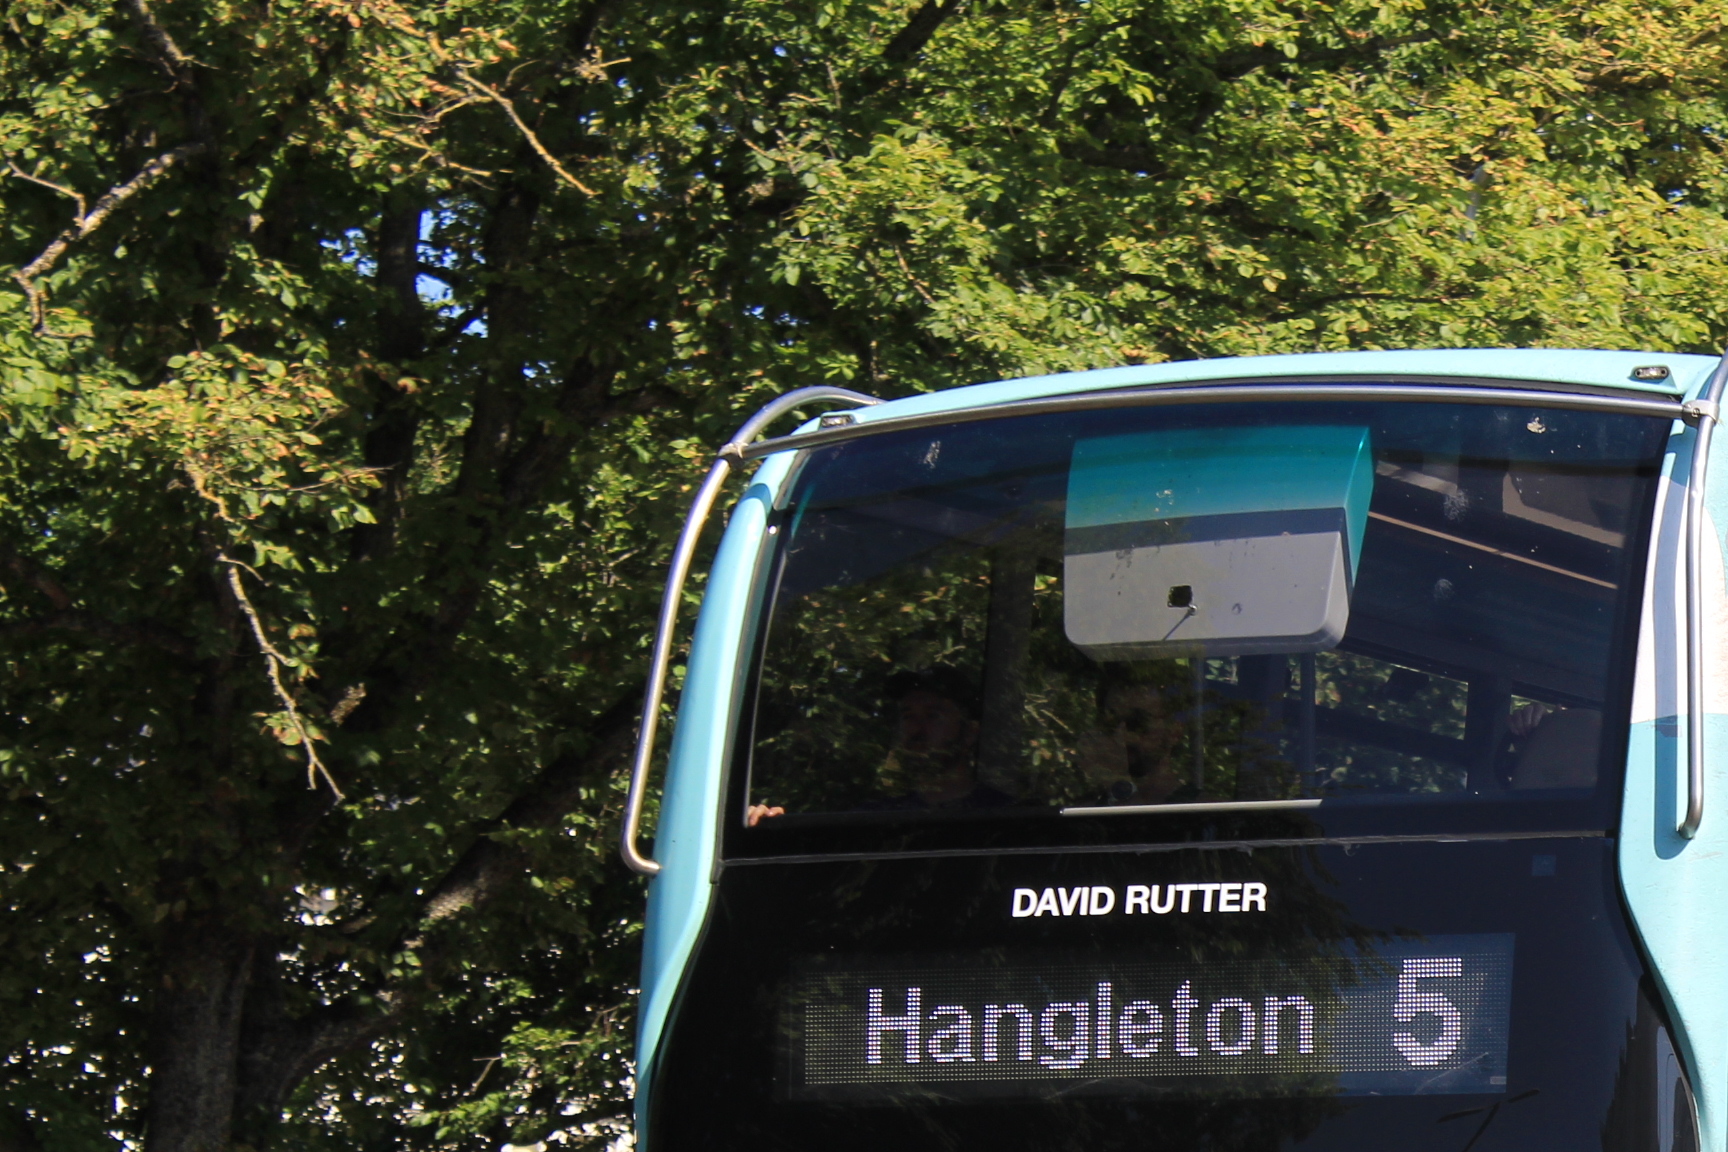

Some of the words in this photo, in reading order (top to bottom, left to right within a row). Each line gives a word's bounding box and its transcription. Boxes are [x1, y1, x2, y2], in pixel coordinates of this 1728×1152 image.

[1012, 885, 1115, 917] DAVID
[1125, 882, 1267, 915] RUTTER
[866, 980, 1314, 1071] Hangleton
[1393, 957, 1463, 1067] 5
